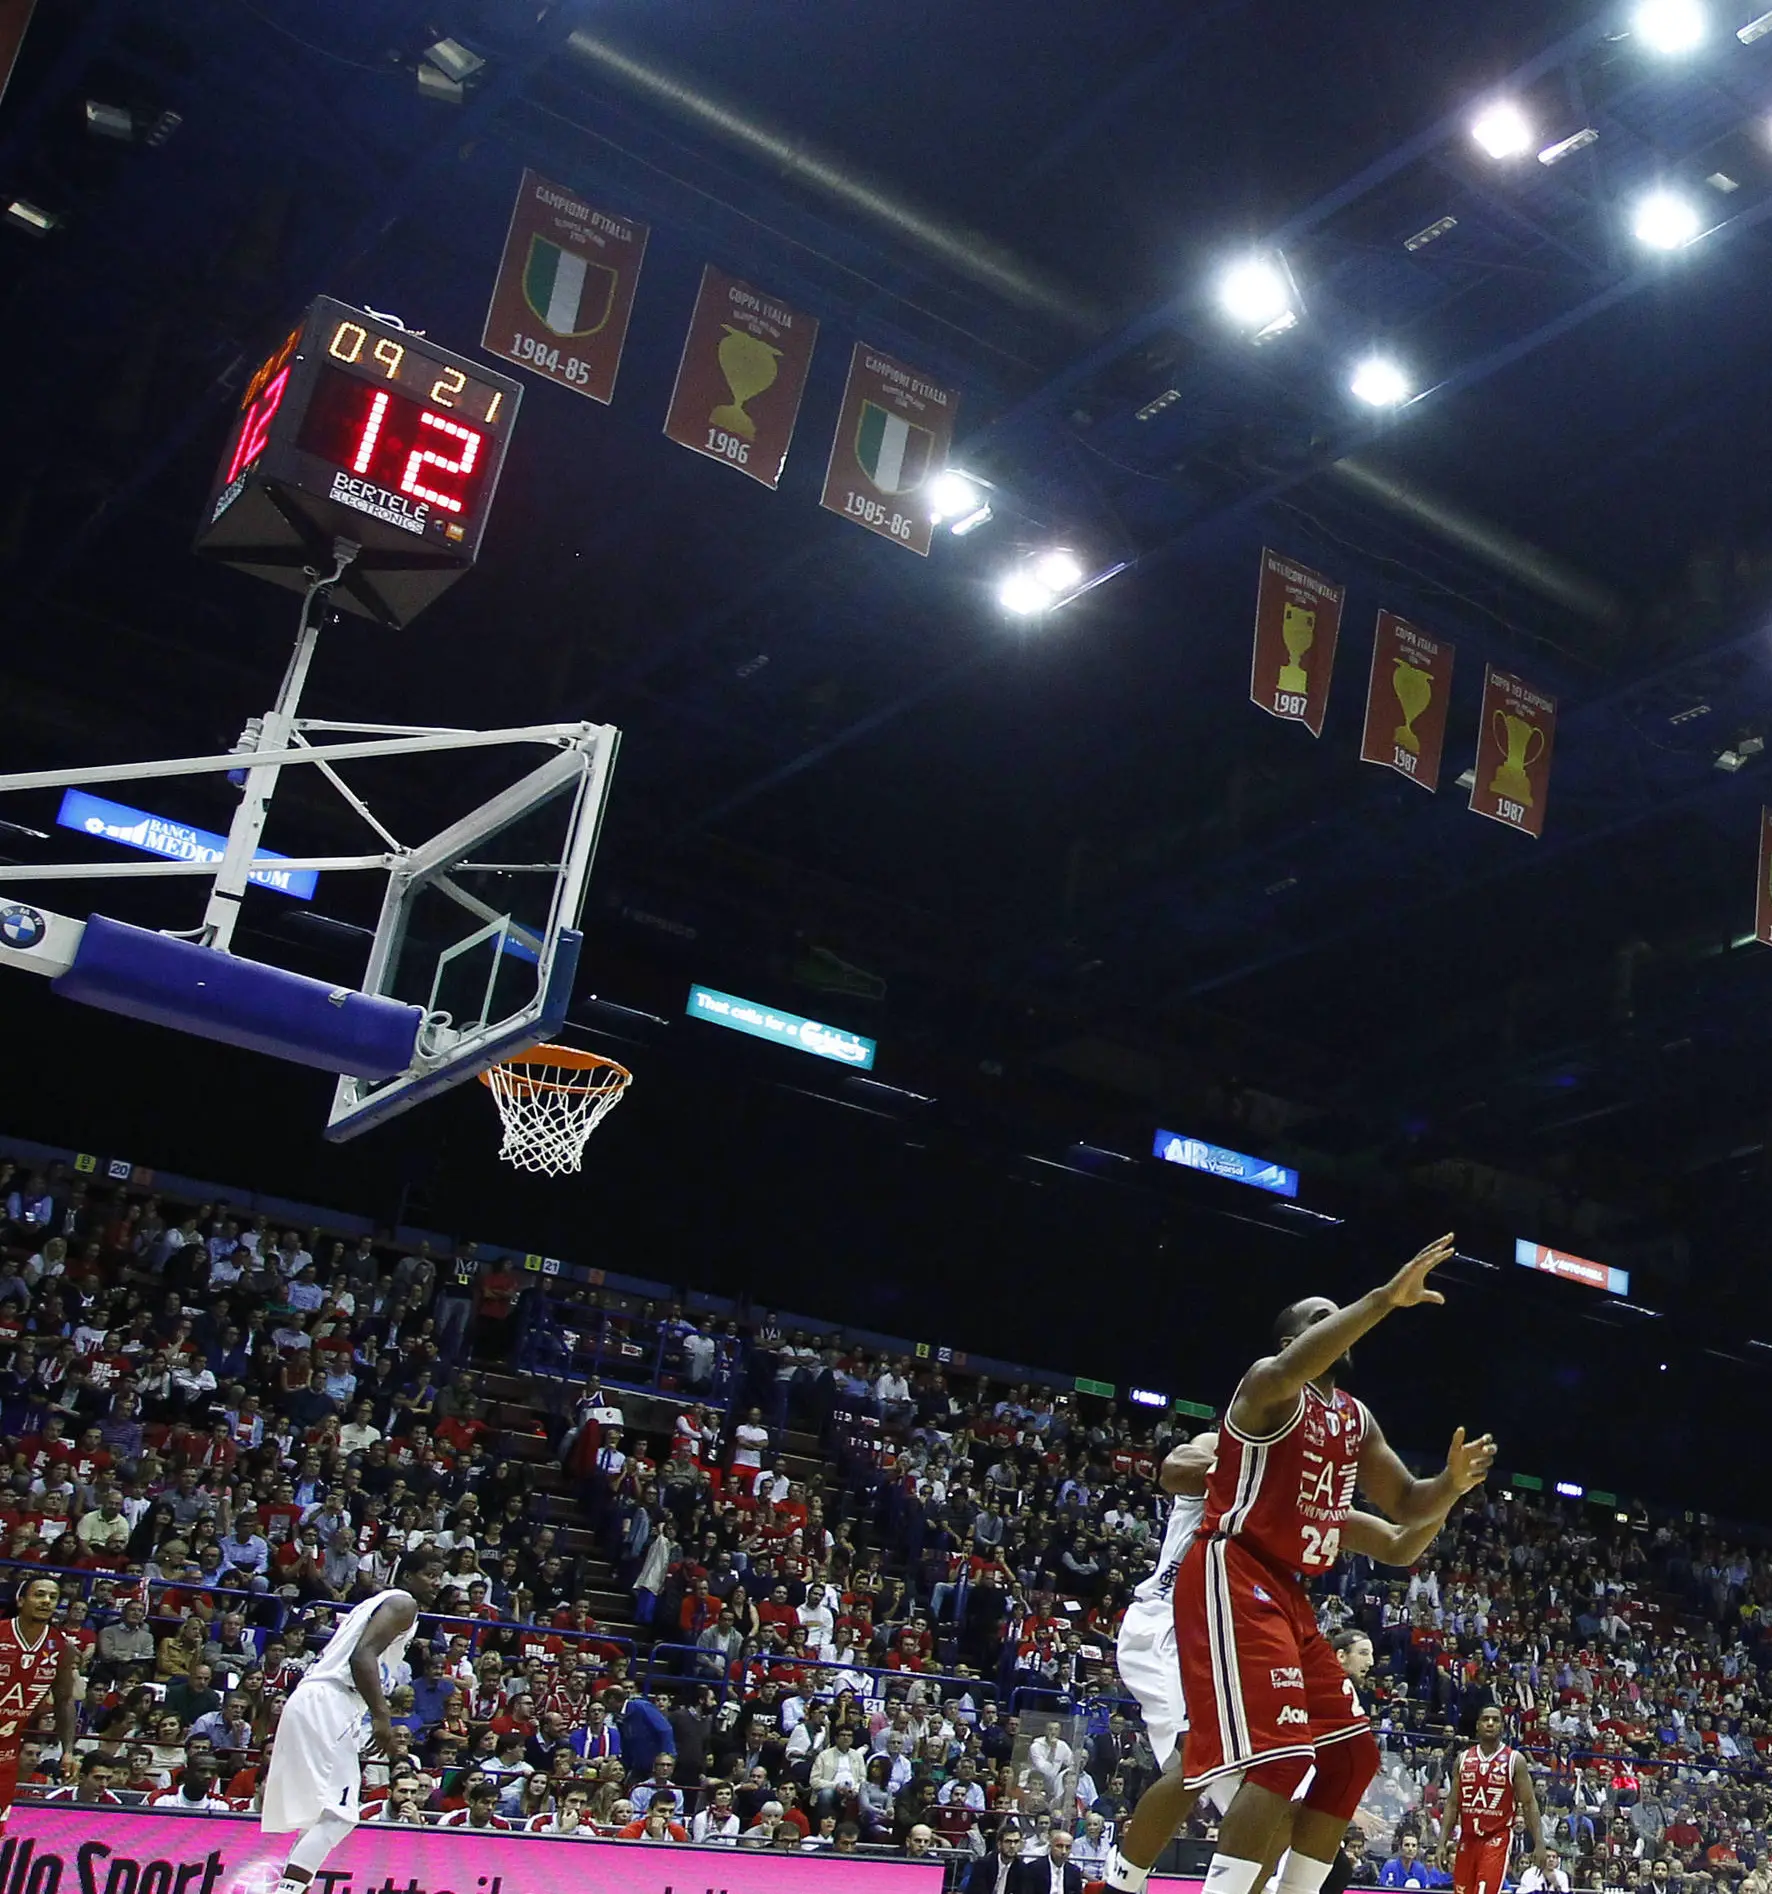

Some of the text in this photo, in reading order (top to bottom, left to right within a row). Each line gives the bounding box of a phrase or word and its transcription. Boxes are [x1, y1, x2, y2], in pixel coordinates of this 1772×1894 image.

[729, 286, 761, 313] COPPA
[763, 299, 793, 330] ITALIA
[328, 321, 404, 380] 09
[429, 366, 503, 424] 21
[510, 332, 593, 385] 1984-85
[865, 356, 911, 389] CAMPIONI
[912, 375, 948, 407] D'ITALIA
[353, 391, 482, 513] 12
[705, 428, 751, 465] 1986
[329, 487, 426, 535] ELECTRONICS
[844, 491, 914, 541] 1985-86
[1274, 692, 1308, 717] 1987
[1393, 745, 1419, 774] 1987
[1495, 797, 1525, 823] 1987
[150, 818, 197, 844] BANCA
[3, 907, 43, 926] BMW
[696, 991, 731, 1014] That
[765, 1015, 786, 1032] for
[786, 1024, 798, 1036] a
[111, 1163, 127, 1176] 20
[1164, 1138, 1210, 1170] AIR
[1300, 1524, 1341, 1567] 24
[865, 1700, 881, 1712] 21
[339, 1785, 350, 1807] 1
[1461, 1785, 1505, 1810] EA7
